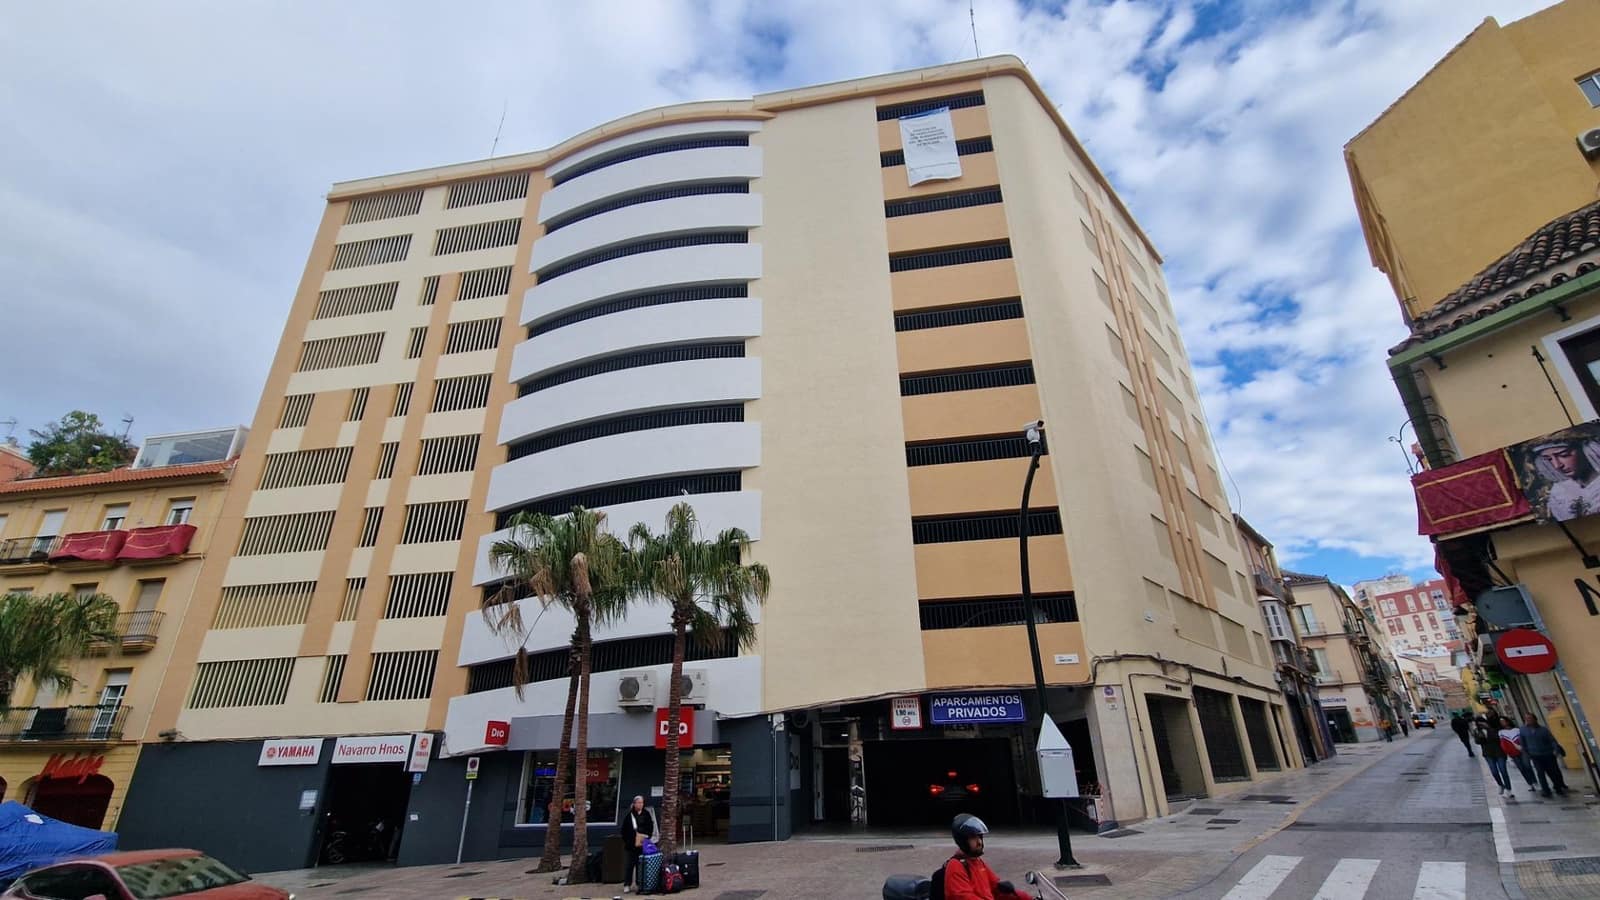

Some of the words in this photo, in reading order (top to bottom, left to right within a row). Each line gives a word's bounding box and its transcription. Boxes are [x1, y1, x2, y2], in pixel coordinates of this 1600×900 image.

[933, 695, 1020, 707] APARCAMIENTOS
[948, 706, 1007, 718] PRIVADOS
[277, 745, 315, 758] YAMAHA
[338, 745, 377, 756] Navarro
